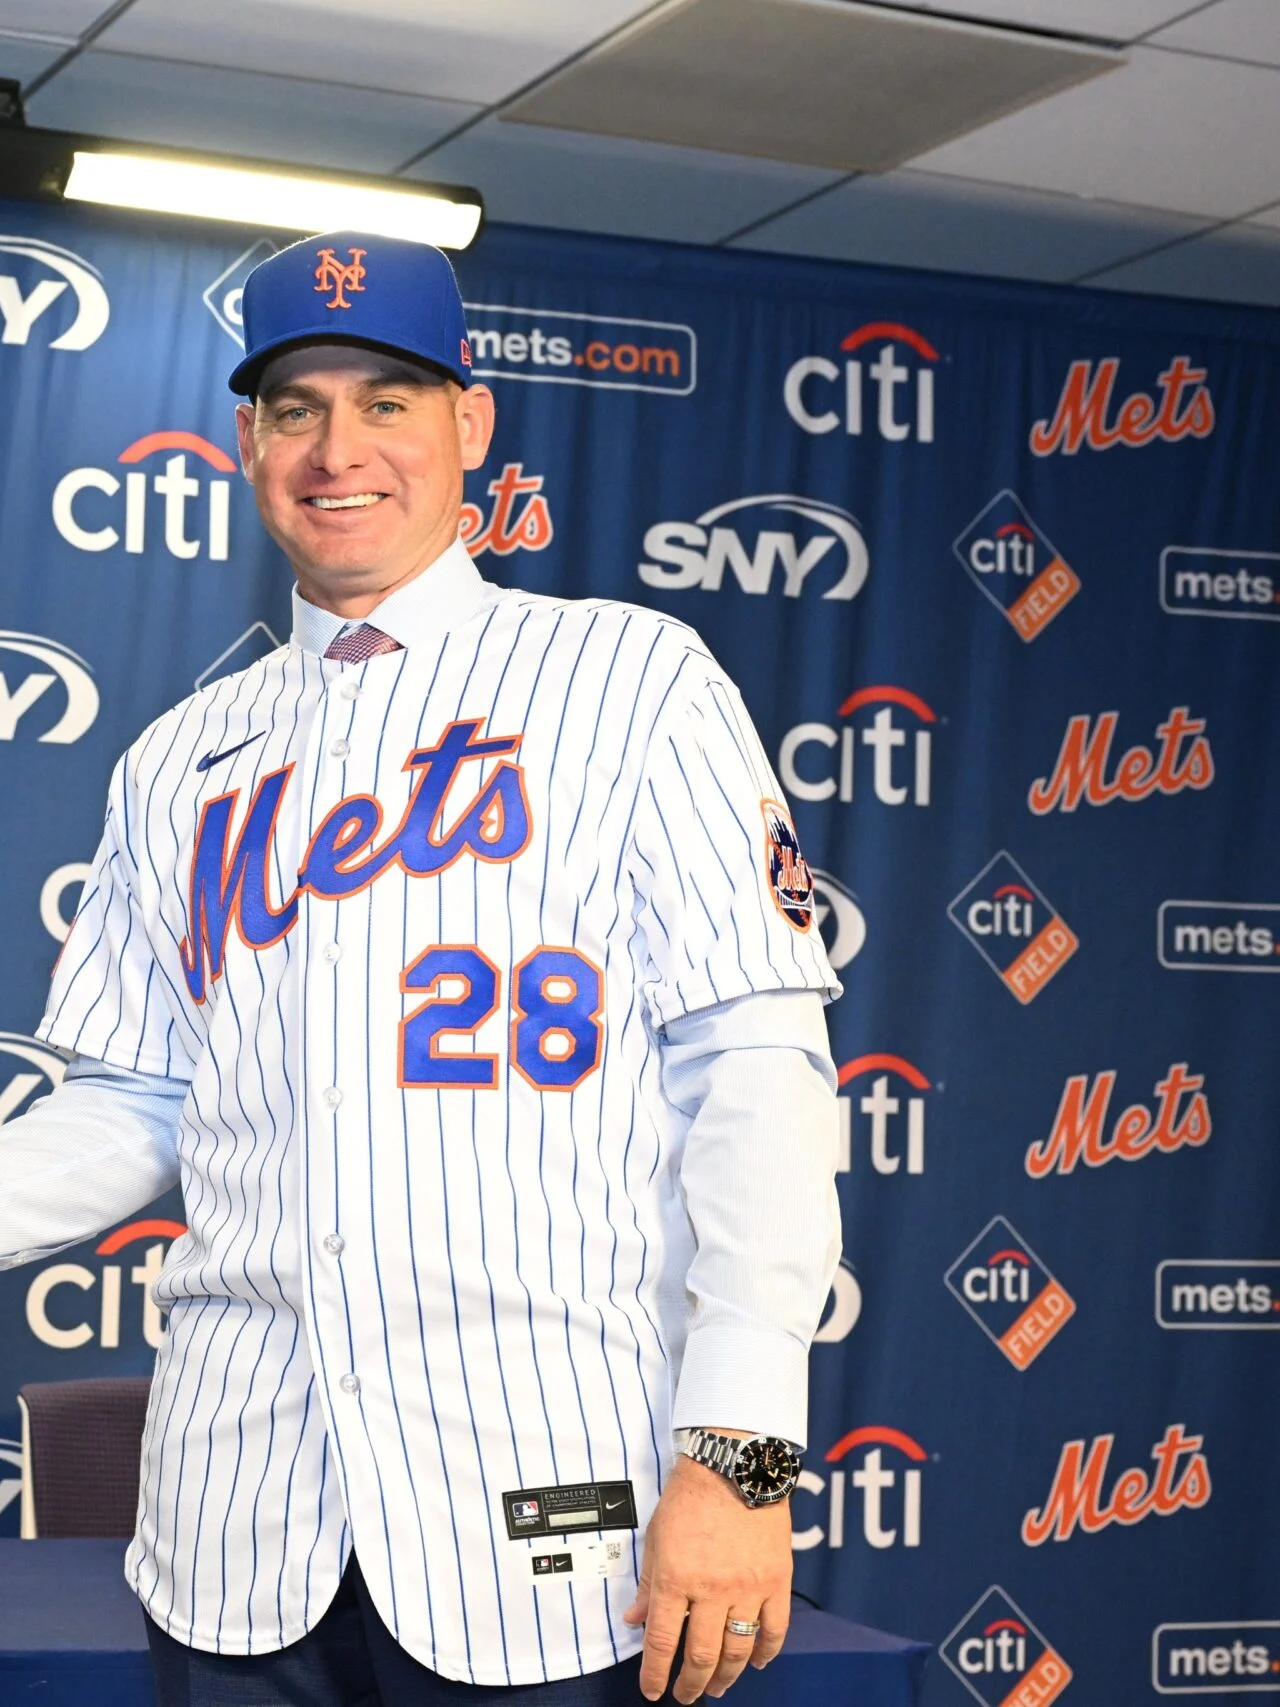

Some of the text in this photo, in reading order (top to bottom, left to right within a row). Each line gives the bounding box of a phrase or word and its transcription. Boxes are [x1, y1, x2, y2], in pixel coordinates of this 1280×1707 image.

[784, 345, 934, 442] citi
[1030, 357, 1215, 457] Mets
[52, 454, 229, 560] citi
[458, 464, 554, 557] ets
[638, 521, 837, 598] SNY
[970, 534, 1034, 576] citi
[1013, 570, 1070, 632] FIELD
[780, 707, 930, 806] citi
[1028, 707, 1215, 815] Mets
[180, 717, 534, 1004] Mets
[967, 894, 1033, 937] citi
[1012, 929, 1069, 995] FIELD
[397, 944, 604, 1092] 28
[836, 1076, 925, 1174] iti
[1025, 1063, 1212, 1179] Mets
[962, 1258, 1030, 1302] citi
[1007, 1293, 1066, 1360] FIELD
[544, 1489, 596, 1500] ENGINEERED
[1022, 1424, 1212, 1546] Mets
[958, 1630, 1026, 1673] citi
